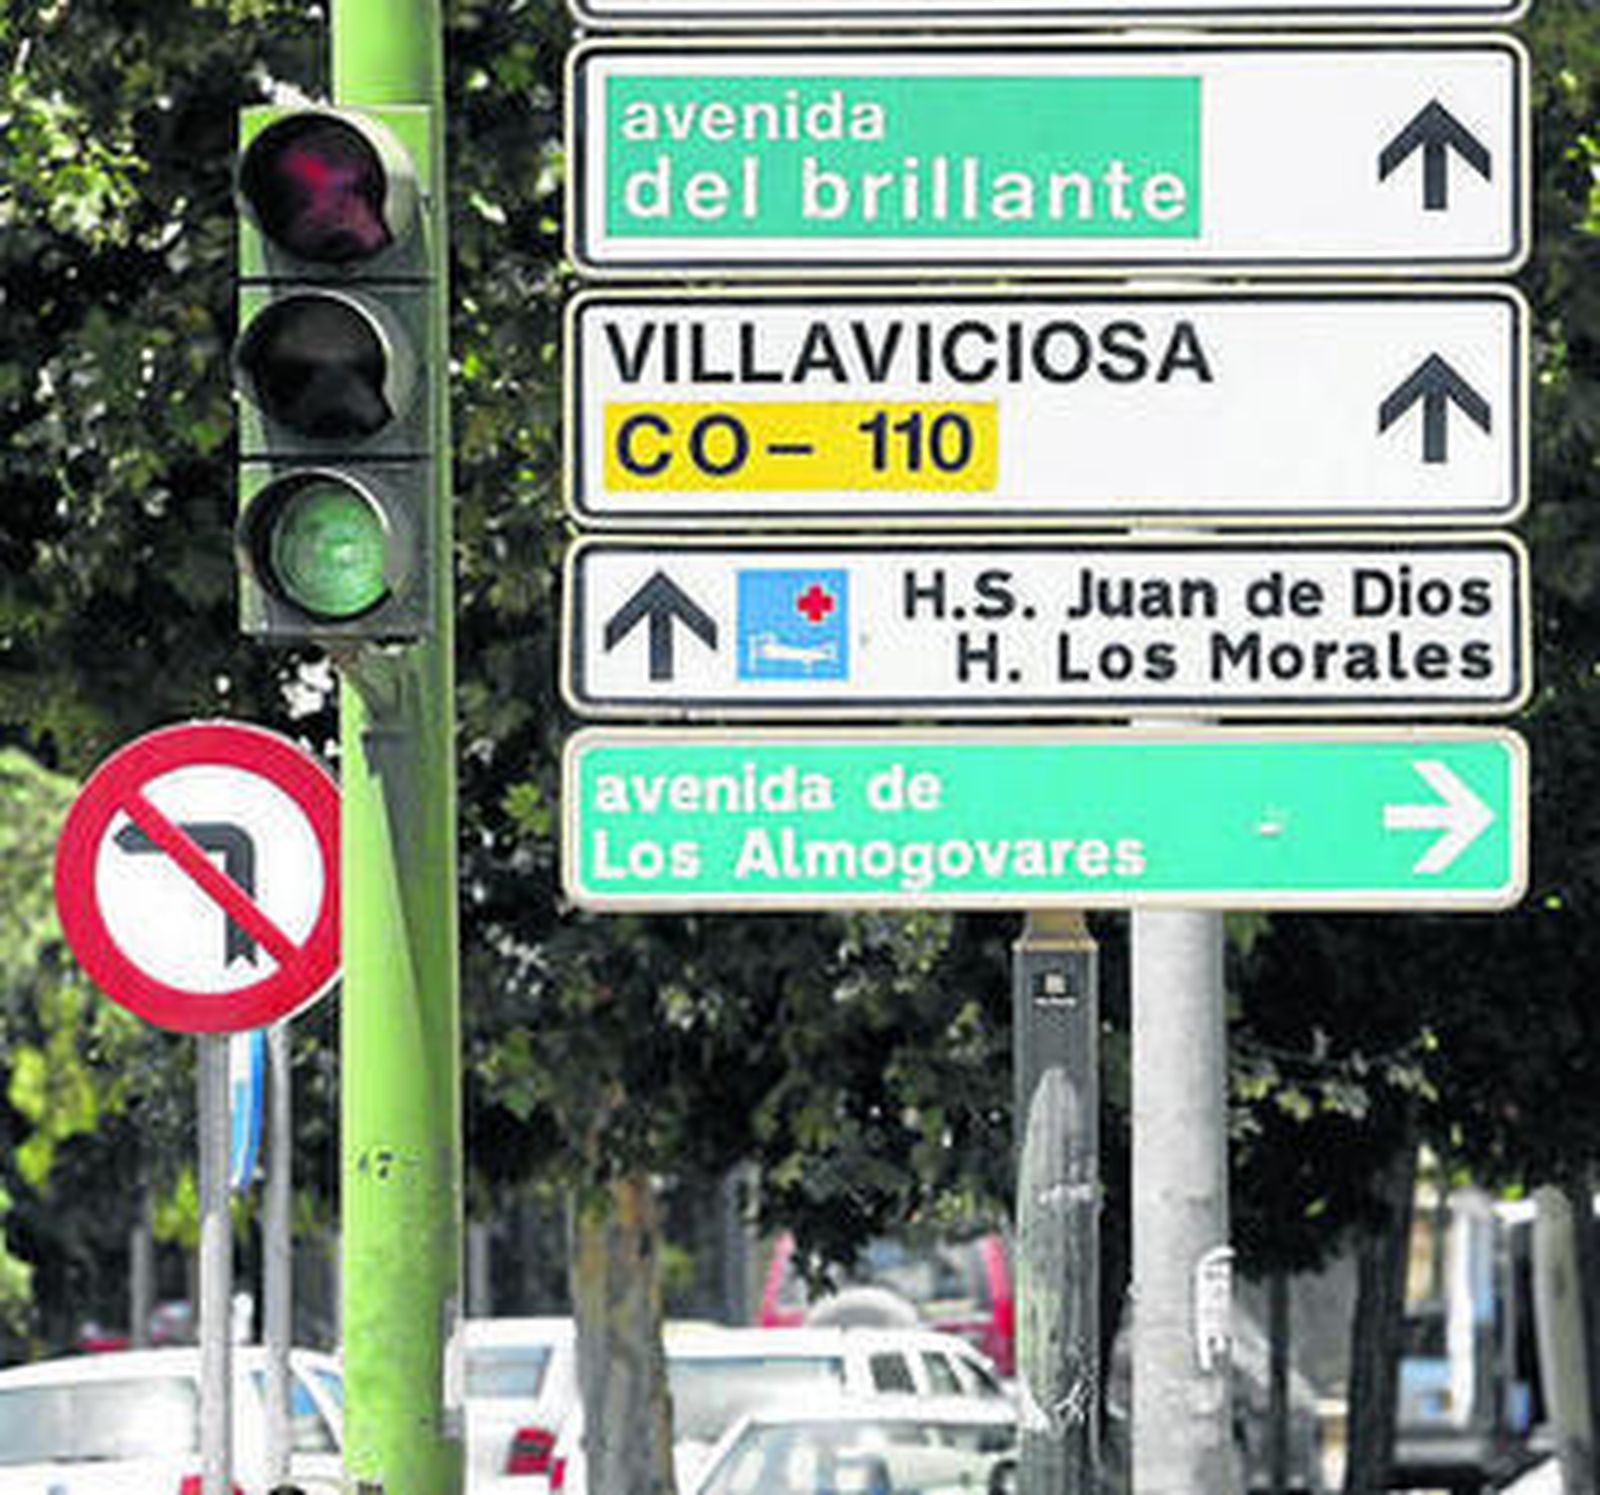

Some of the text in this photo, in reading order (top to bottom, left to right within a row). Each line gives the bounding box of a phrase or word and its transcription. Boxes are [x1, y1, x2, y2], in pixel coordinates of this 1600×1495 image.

[621, 89, 885, 141] avenida
[623, 156, 1188, 221] del brillante
[605, 321, 1213, 384] VILLAVICIOSA
[859, 411, 973, 472] 110
[904, 565, 1493, 620] H.S. Juan de Dios
[957, 631, 1493, 682] H. Los Morales
[593, 762, 941, 813] avenida de
[593, 828, 1147, 889] Los Almogovares
